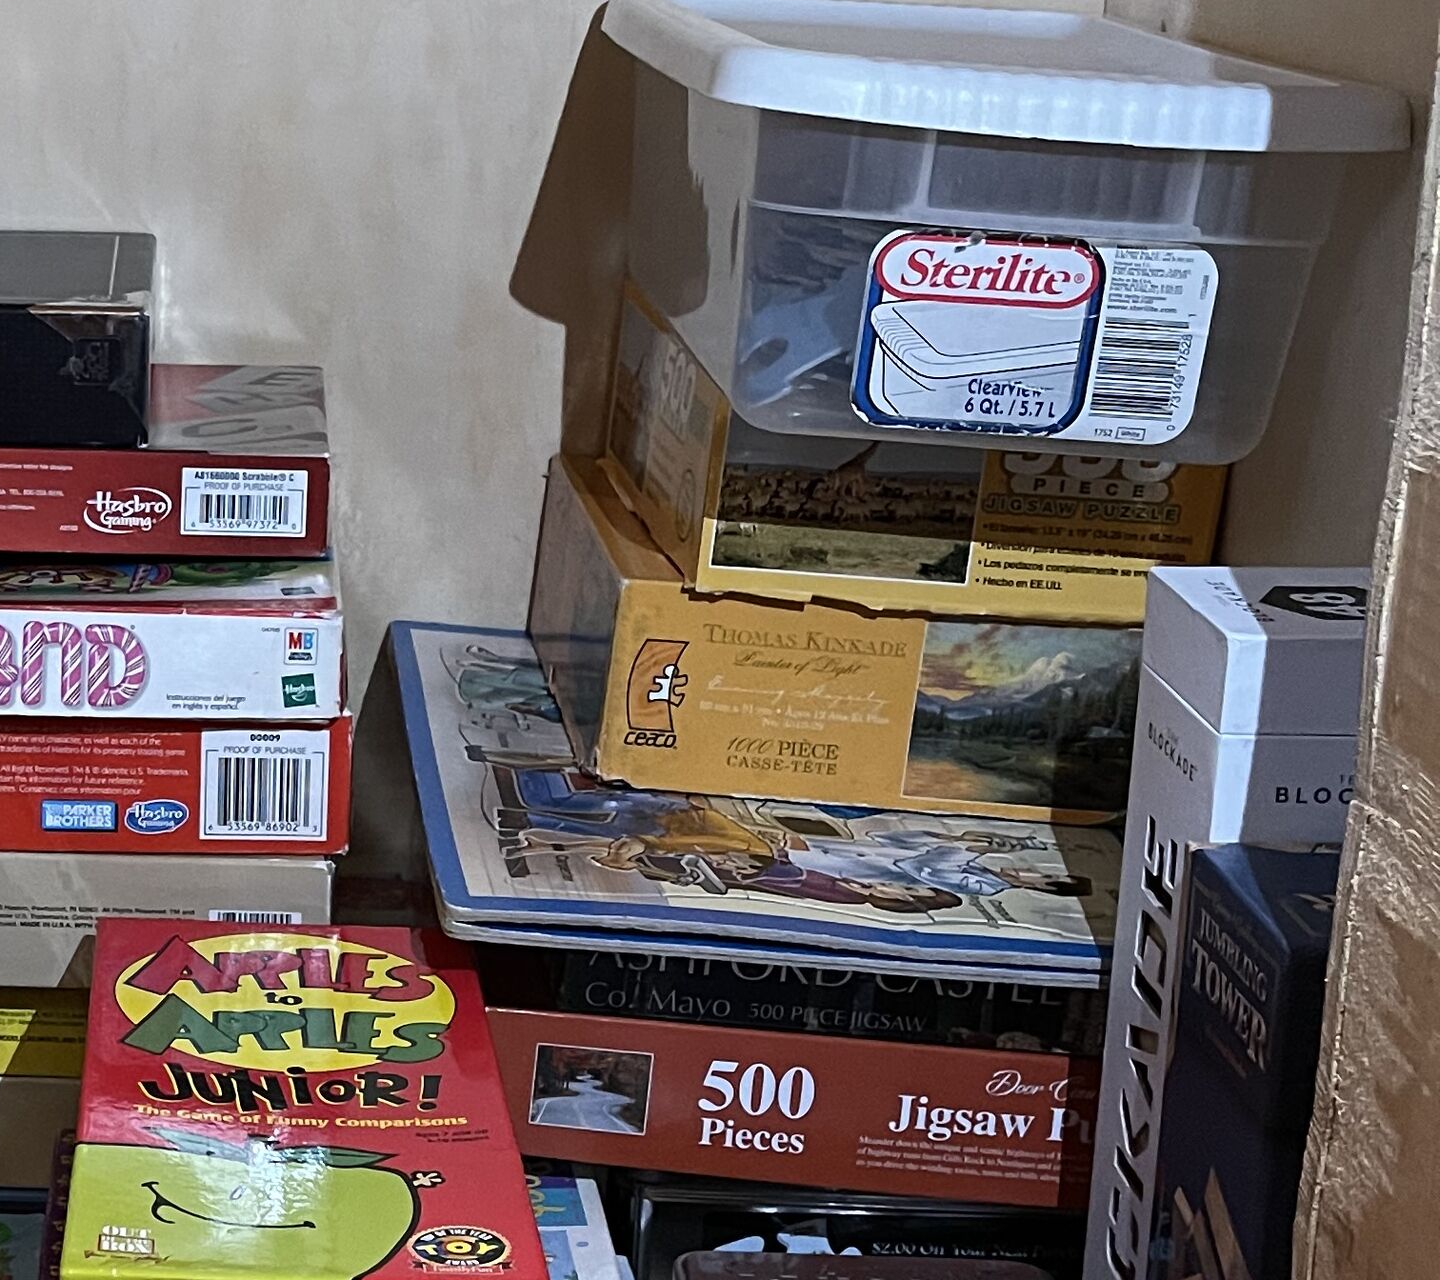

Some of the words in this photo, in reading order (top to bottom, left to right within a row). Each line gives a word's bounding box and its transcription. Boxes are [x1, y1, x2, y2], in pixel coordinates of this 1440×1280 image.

[899, 247, 1074, 297] Sterilite
[964, 399, 975, 414] 6
[978, 399, 1005, 417] Qt.
[1017, 401, 1046, 418] 5.7
[204, 481, 229, 489] PROOF
[1032, 477, 1146, 499] PIECE
[88, 489, 166, 516] Hasbro
[982, 493, 1079, 516] JIGSAW
[1082, 502, 1181, 525] PUZZLE
[100, 511, 153, 531] Gaming
[288, 631, 314, 650] MB
[702, 623, 798, 650] THOMAS
[1147, 721, 1198, 782] BLOCKADE
[45, 814, 112, 828] BROTHERS
[62, 804, 112, 816] PARKER
[132, 804, 184, 822] Hasbro
[125, 935, 437, 1002] APPLES
[1198, 906, 1269, 1004] JUMBLING
[646, 989, 731, 1020] Mayo
[749, 1001, 784, 1021] 500
[849, 1008, 928, 1035] JIGSAW
[1190, 943, 1269, 1077] TOWER
[120, 993, 451, 1063] APPLES
[697, 1059, 816, 1120] 500
[985, 1069, 1045, 1098] Door
[134, 1103, 170, 1119] The
[176, 1107, 235, 1126] Game
[238, 1112, 261, 1126] of
[267, 1115, 329, 1132] Funny
[335, 1114, 469, 1131] Comparisons
[888, 1094, 1036, 1143] Jigsaw
[699, 1117, 806, 1156] Pieces
